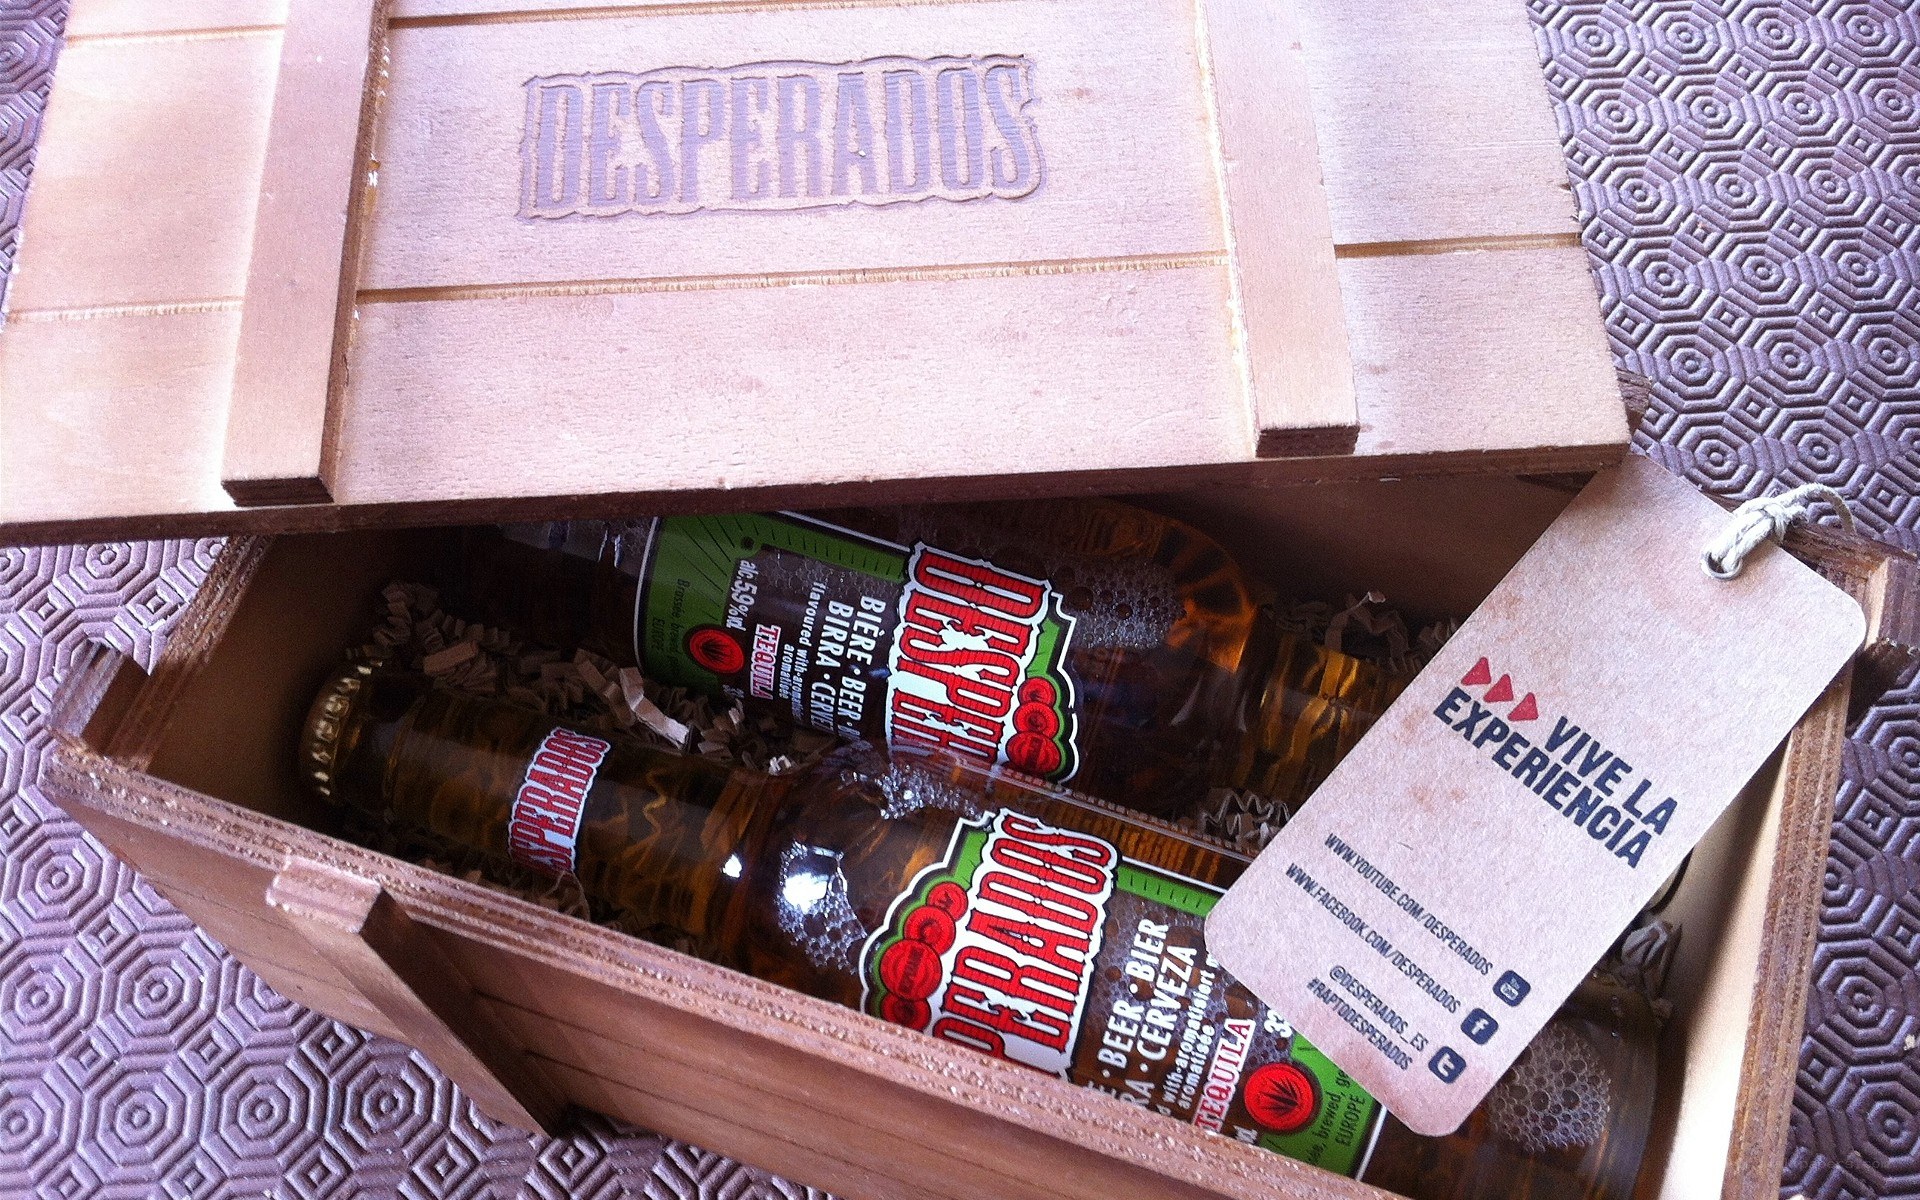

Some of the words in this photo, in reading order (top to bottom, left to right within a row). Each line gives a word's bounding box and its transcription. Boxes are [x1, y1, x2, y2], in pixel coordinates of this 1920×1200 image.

[535, 64, 1032, 208] DESPERADOS
[750, 625, 779, 700] TEQUILA
[799, 580, 826, 648] flavoured
[815, 599, 853, 669] BIRRA
[847, 595, 887, 666] BIÈRE
[838, 675, 867, 725] BEER
[1433, 687, 1654, 869] EXPERIENCIA
[1544, 716, 1632, 795] VIVE
[1622, 777, 1679, 836] LA
[1285, 863, 1461, 1014] WWW.FACEBOOK.COM/DESPERADOS
[1324, 833, 1493, 976] WWW.YOUTUBE.COM/DESPERADOS
[1097, 1000, 1145, 1070] BEER
[1124, 917, 1170, 982] BIER
[1137, 944, 1198, 1063] CERVEZA
[1306, 976, 1413, 1071] #RAPTODESPERADOS
[1329, 964, 1429, 1052] @DESPERADOS_ES
[1197, 1022, 1252, 1133] TEQUILA
[1335, 1093, 1367, 1149] EUROPE
